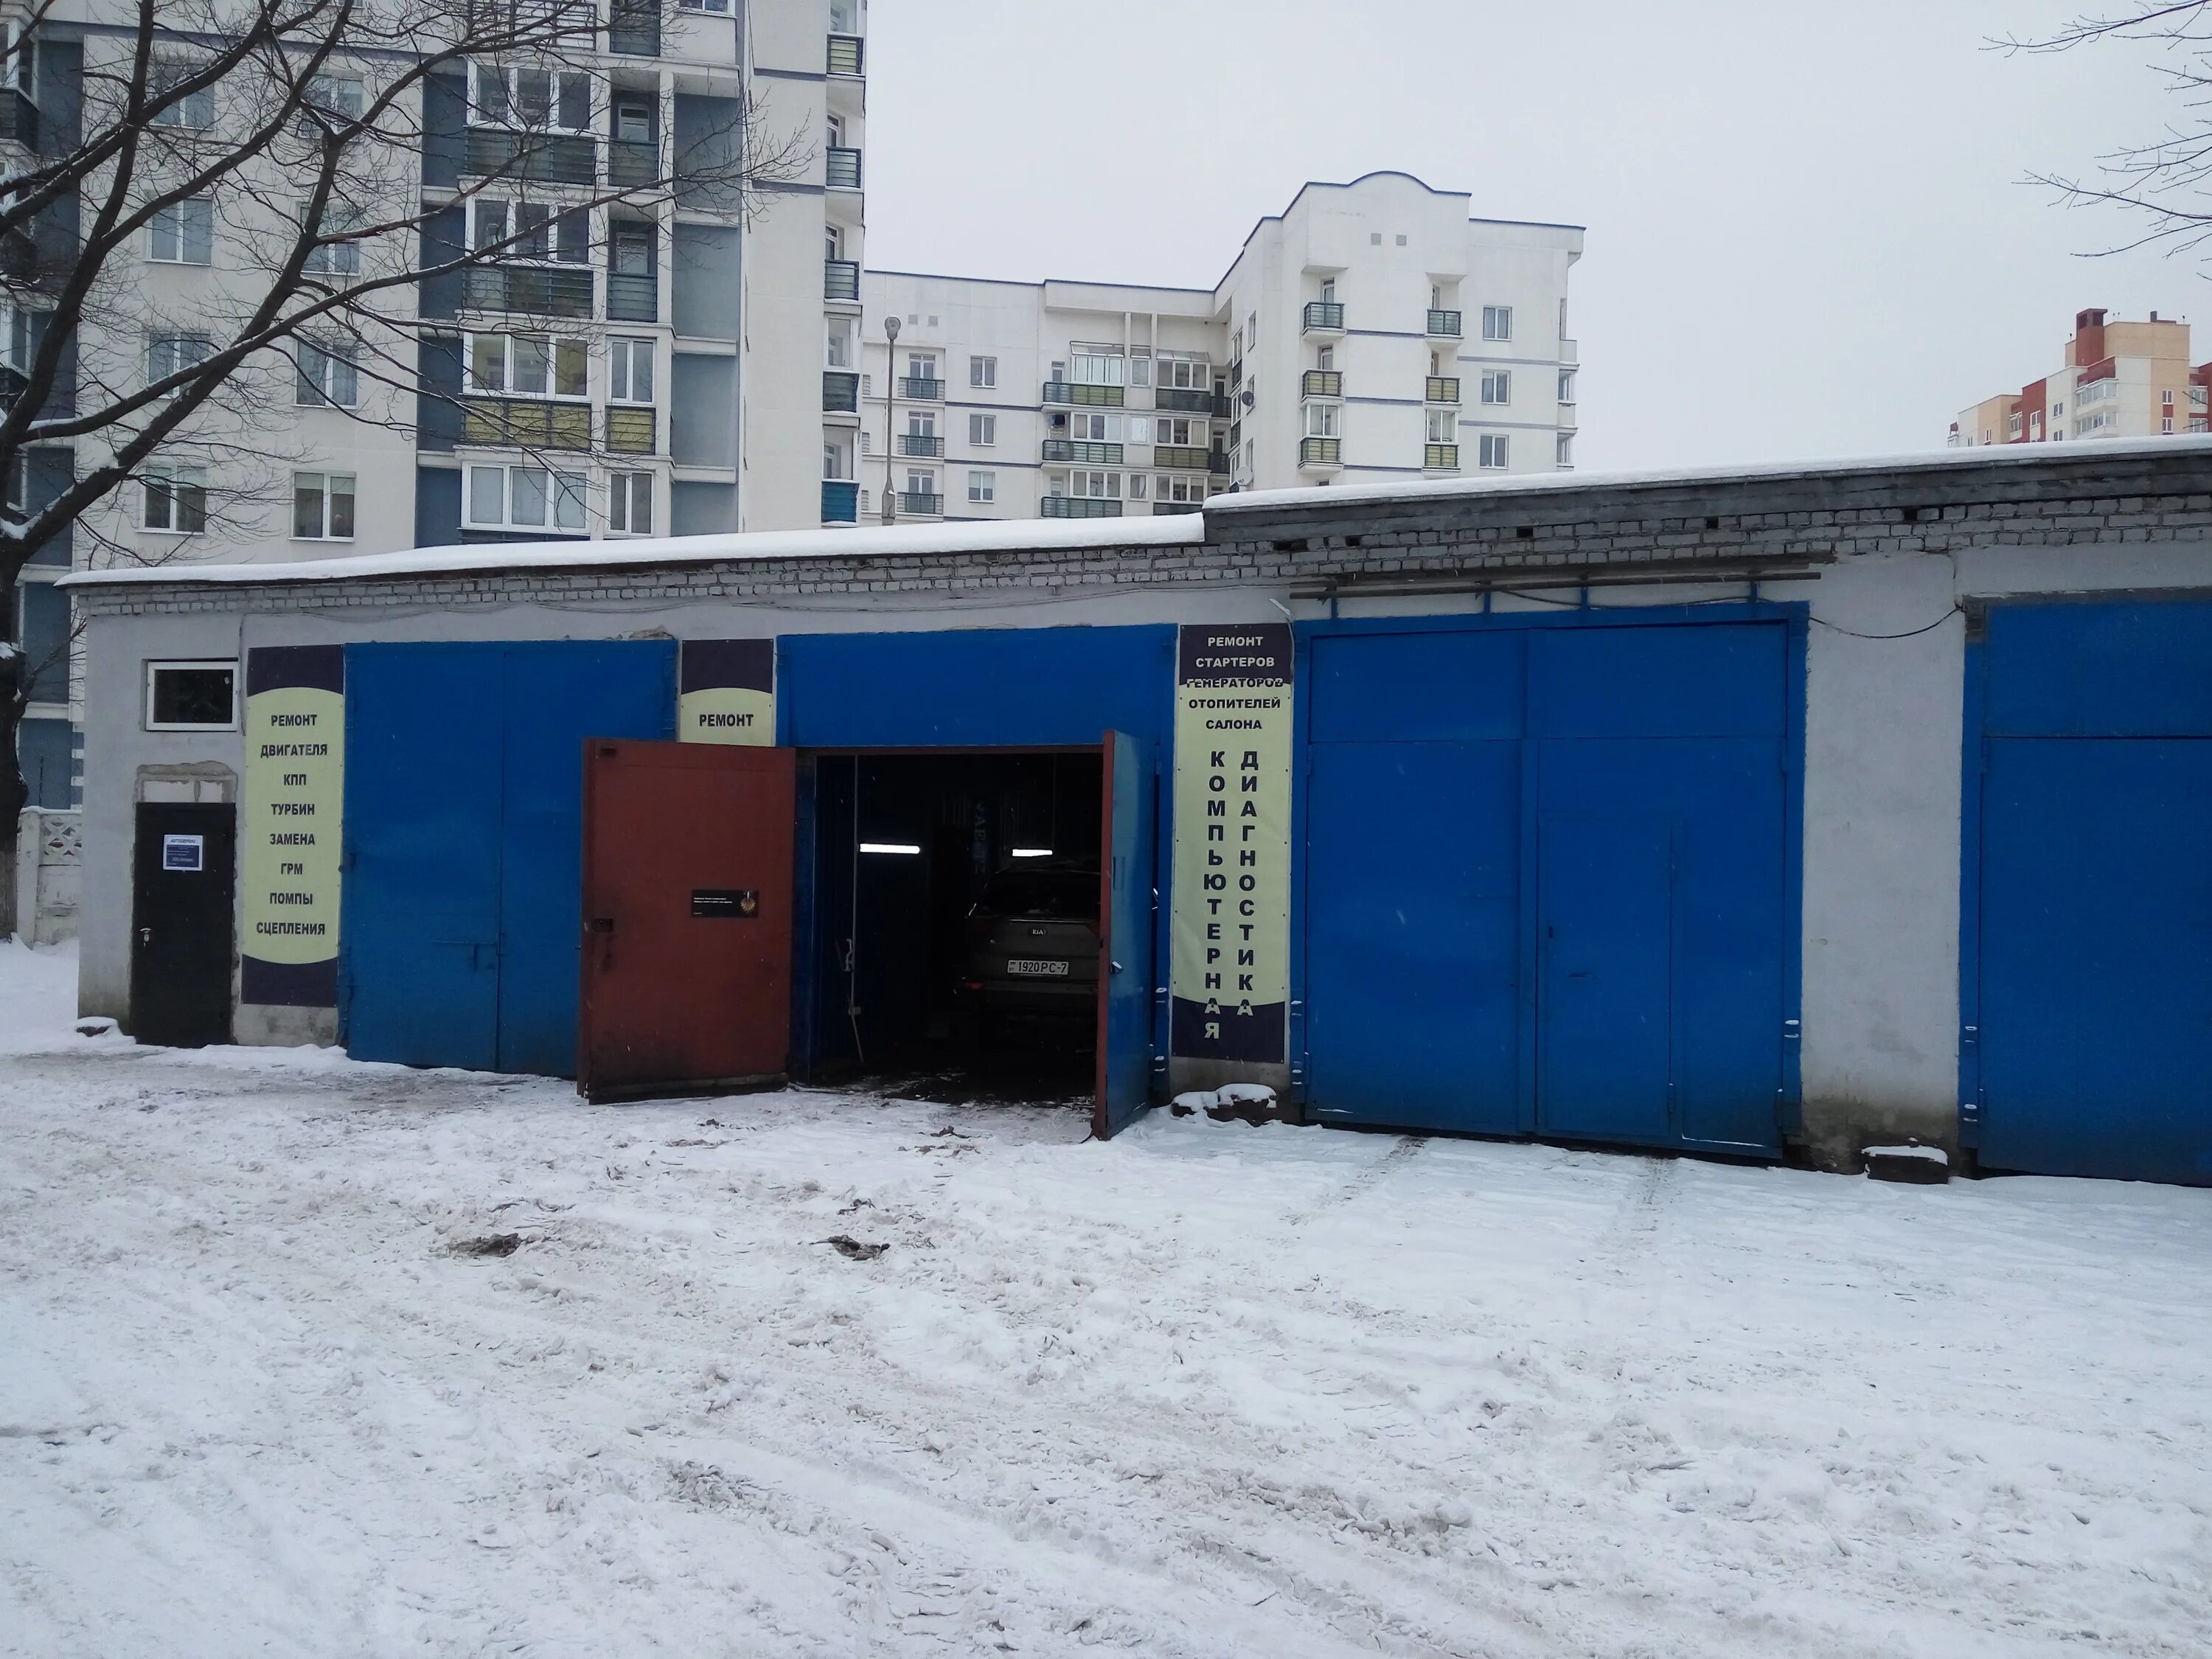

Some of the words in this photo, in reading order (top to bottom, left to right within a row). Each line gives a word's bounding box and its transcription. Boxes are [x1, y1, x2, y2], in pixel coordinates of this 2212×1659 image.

[1208, 636, 1263, 647] РЕМОНТ
[1195, 657, 1275, 667] СТАРТЕРОВ
[1186, 678, 1284, 688] ГЕНЕРАТОРОВ
[1189, 697, 1281, 709] ОТОПИТЕЛЕЙ
[270, 714, 317, 727] РЕМОНТ
[699, 714, 754, 727] РЕМОНТ
[1206, 720, 1262, 729] САЛОНА
[260, 744, 328, 758] ДВИГАТЕЛЯ
[283, 774, 307, 786] КПП
[271, 804, 316, 816] ТУРБИН
[269, 834, 316, 846] ЗАМЕНА
[280, 863, 303, 875] ГРМ
[1237, 751, 1259, 1017] ДИАГНОСТИКА
[269, 893, 313, 905] ПОМПЫ
[1203, 751, 1226, 1040] КОМПЬЮТЕРНАЯ
[256, 922, 326, 936] СЦЕПЛЕНИЯ
